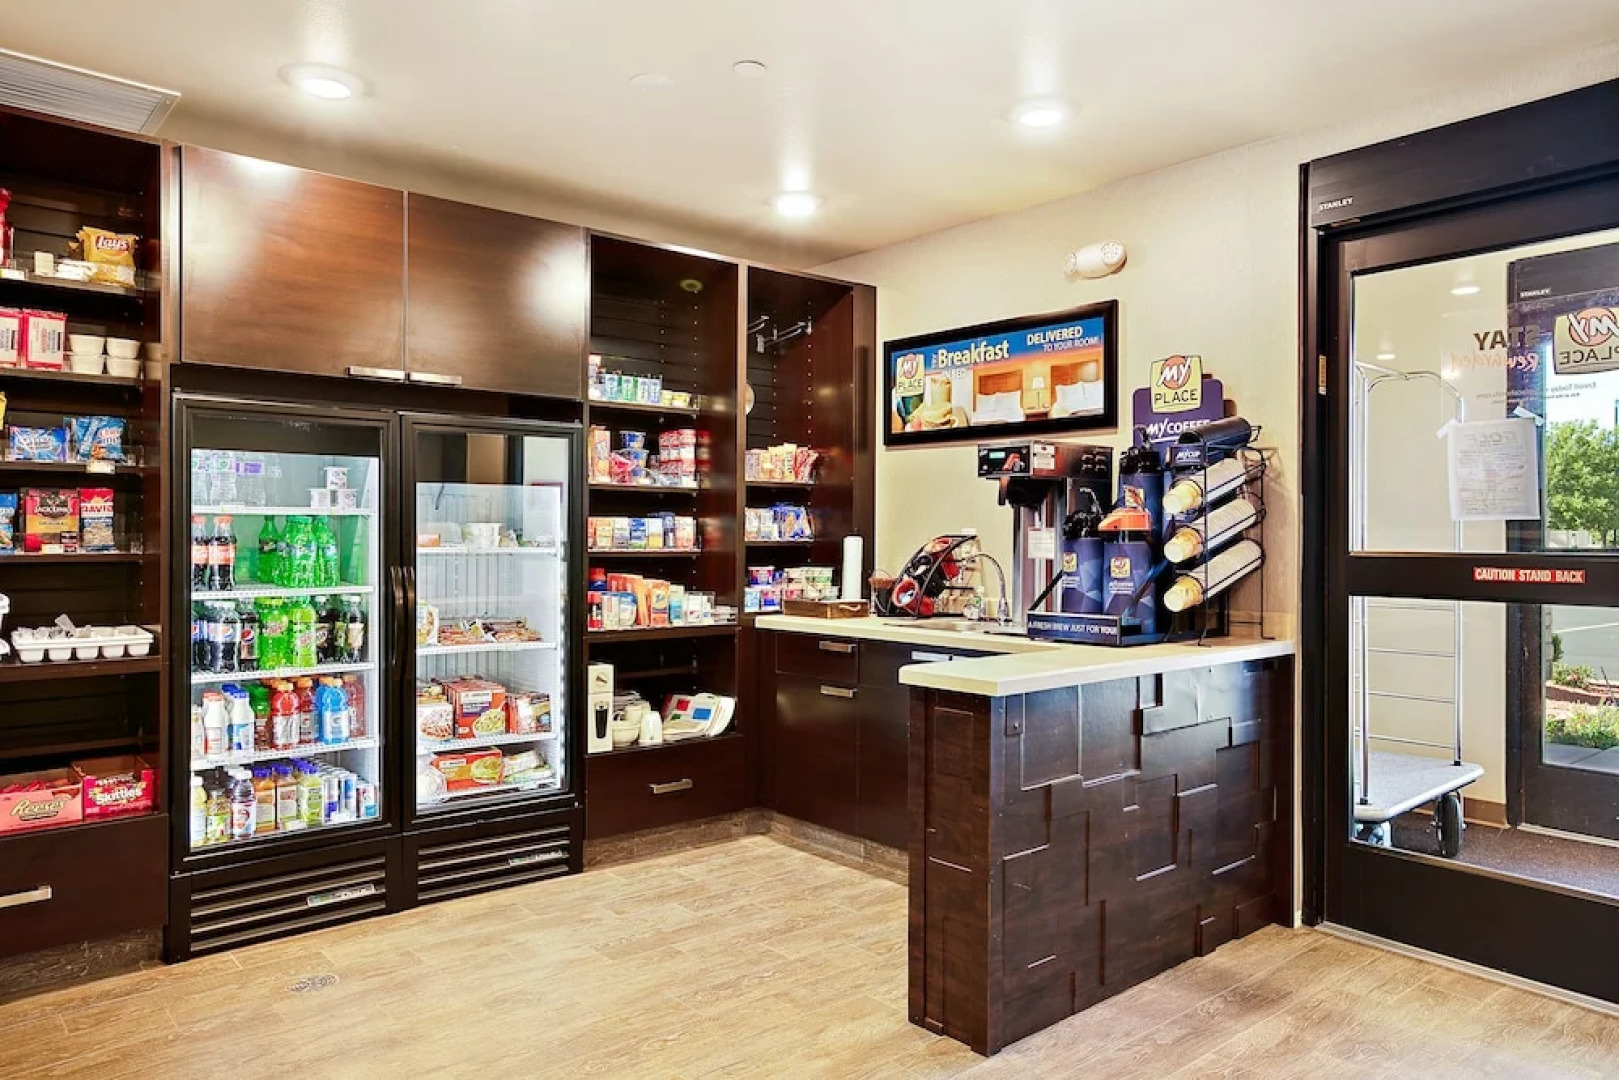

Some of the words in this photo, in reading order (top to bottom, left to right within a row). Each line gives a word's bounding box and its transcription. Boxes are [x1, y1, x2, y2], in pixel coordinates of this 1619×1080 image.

[1318, 197, 1353, 211] STANLEY
[1027, 326, 1083, 346] DELIVERED
[938, 340, 1010, 368] Breakfast
[898, 379, 922, 391] PLACE
[1154, 389, 1198, 405] PLACE
[1475, 567, 1515, 581] CAUTION
[1519, 569, 1551, 582] STAND
[1555, 570, 1583, 583] BACK
[1086, 625, 1100, 633] FOR
